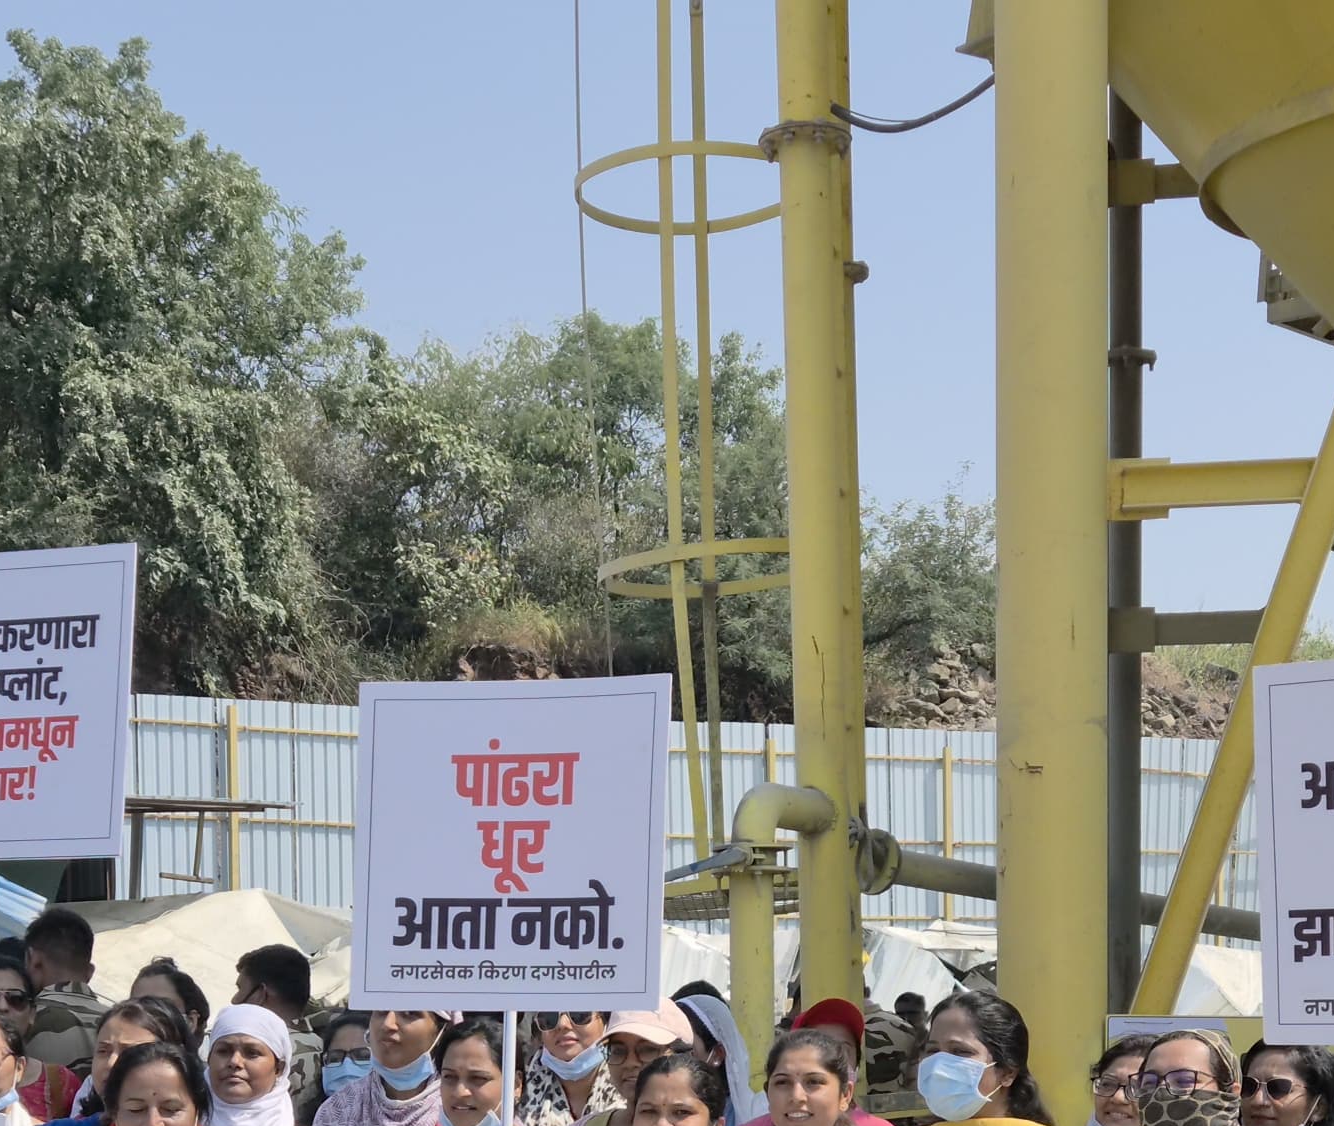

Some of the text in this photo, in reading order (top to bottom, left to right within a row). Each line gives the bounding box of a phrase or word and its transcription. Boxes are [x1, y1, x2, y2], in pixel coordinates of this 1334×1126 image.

[450, 738, 581, 807] पांढरा
[476, 820, 551, 894] धूर
[392, 878, 625, 951] आता नको.
[389, 959, 618, 981] नगरसेवक किरण दगडेपाटील
